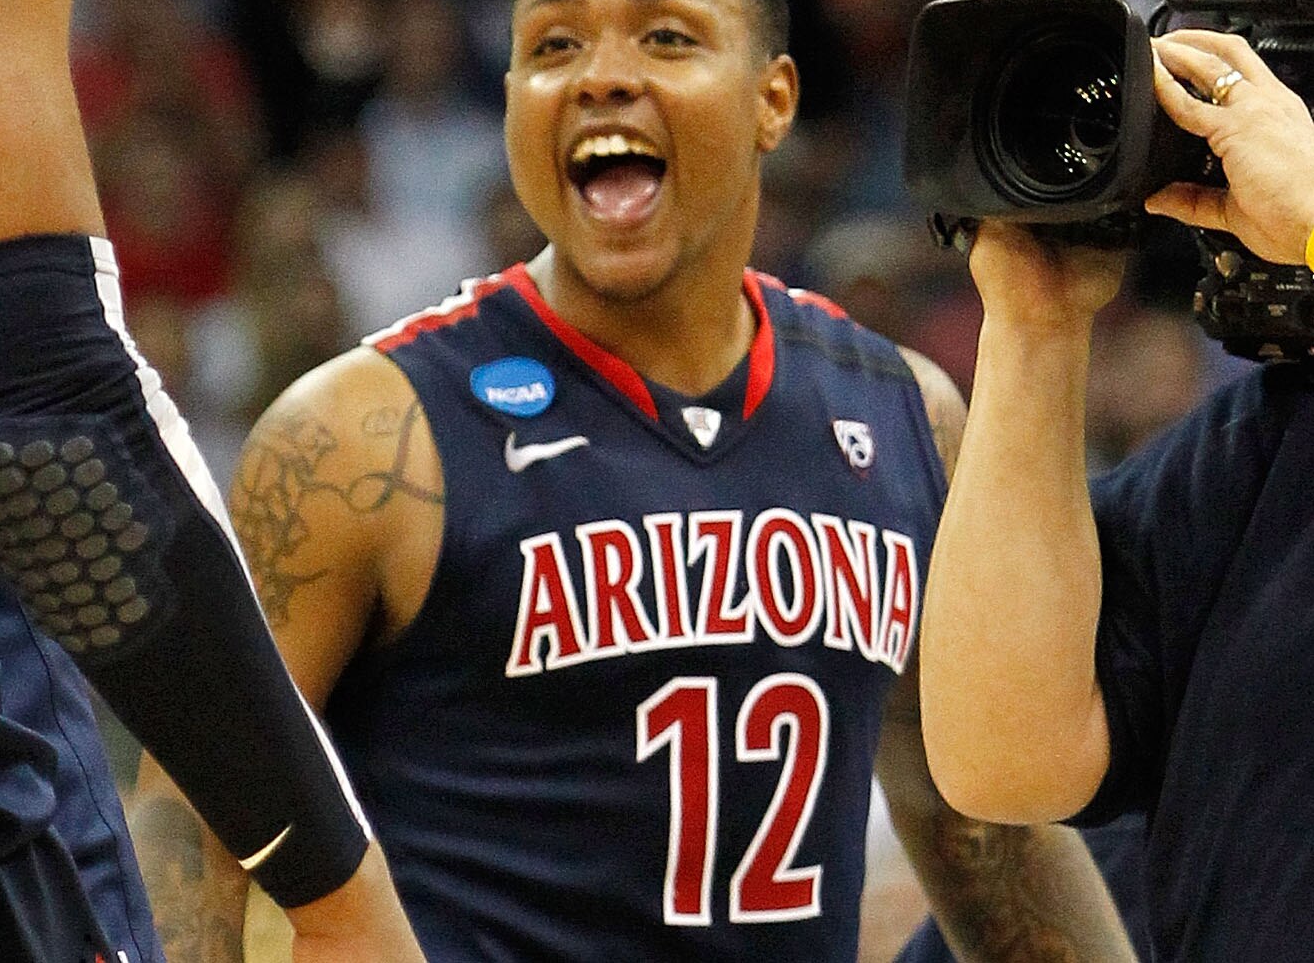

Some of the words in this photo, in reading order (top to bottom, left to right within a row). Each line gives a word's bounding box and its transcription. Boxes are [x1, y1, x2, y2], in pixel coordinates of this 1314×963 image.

[484, 382, 546, 405] NCAA
[505, 508, 920, 678] ARIZONA
[636, 673, 830, 927] 12
